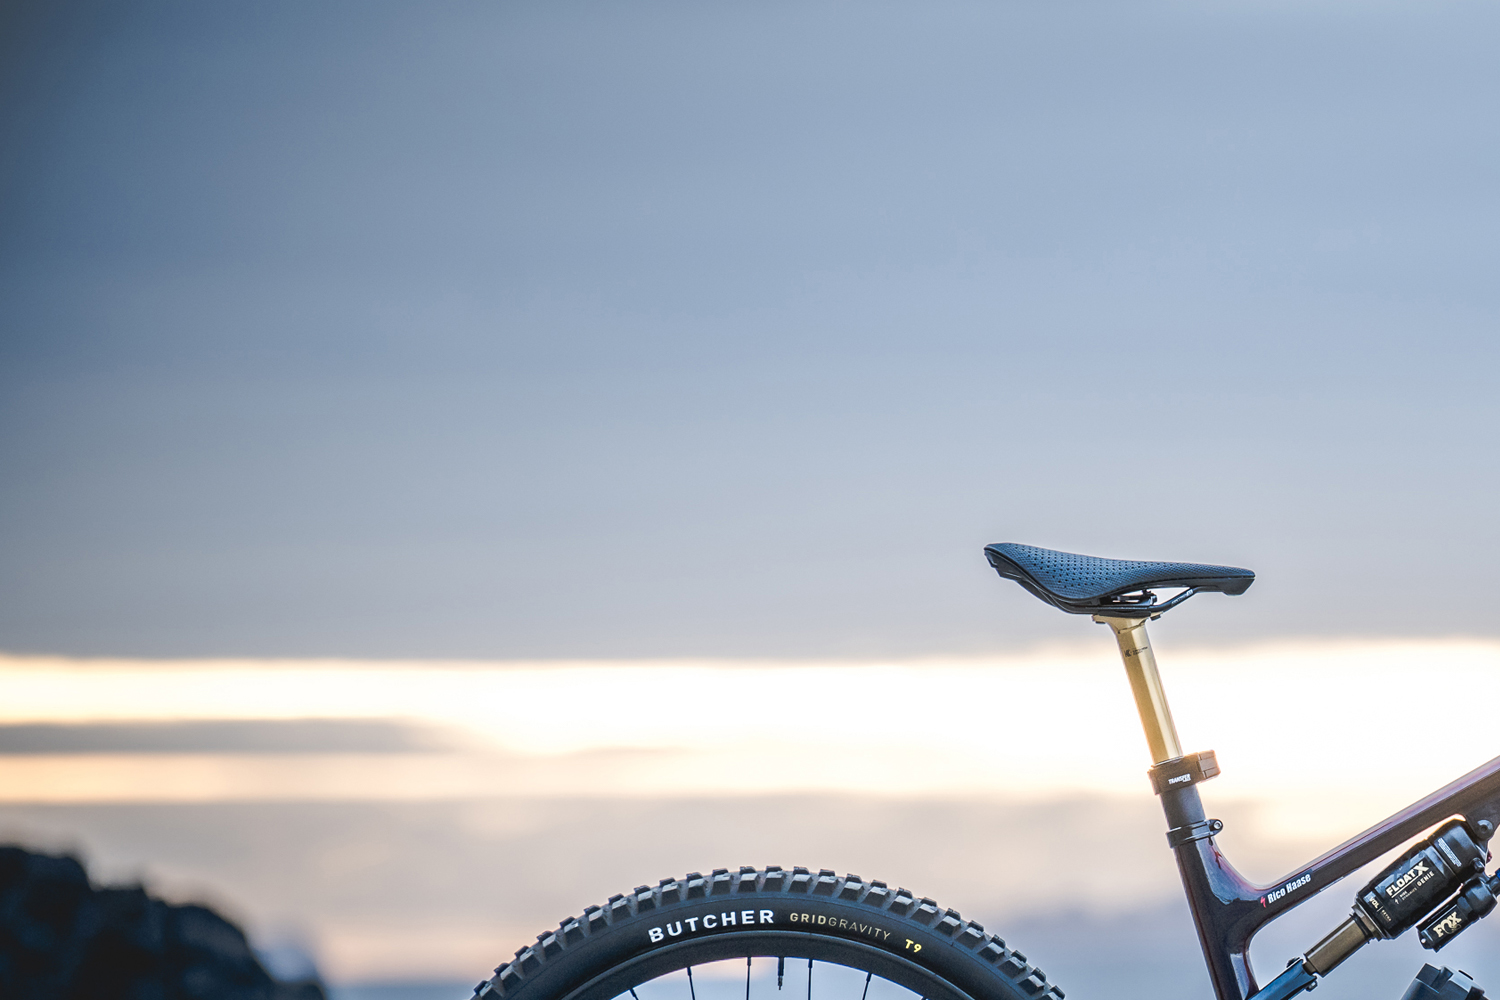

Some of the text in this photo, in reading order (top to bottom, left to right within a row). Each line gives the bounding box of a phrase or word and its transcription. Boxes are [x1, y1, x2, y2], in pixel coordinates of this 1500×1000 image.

[1267, 873, 1312, 904] Rico Haase
[1417, 871, 1435, 887] GENIE
[648, 908, 775, 943] BUTCHER
[904, 938, 923, 954] T9
[1432, 911, 1462, 938] FOX
